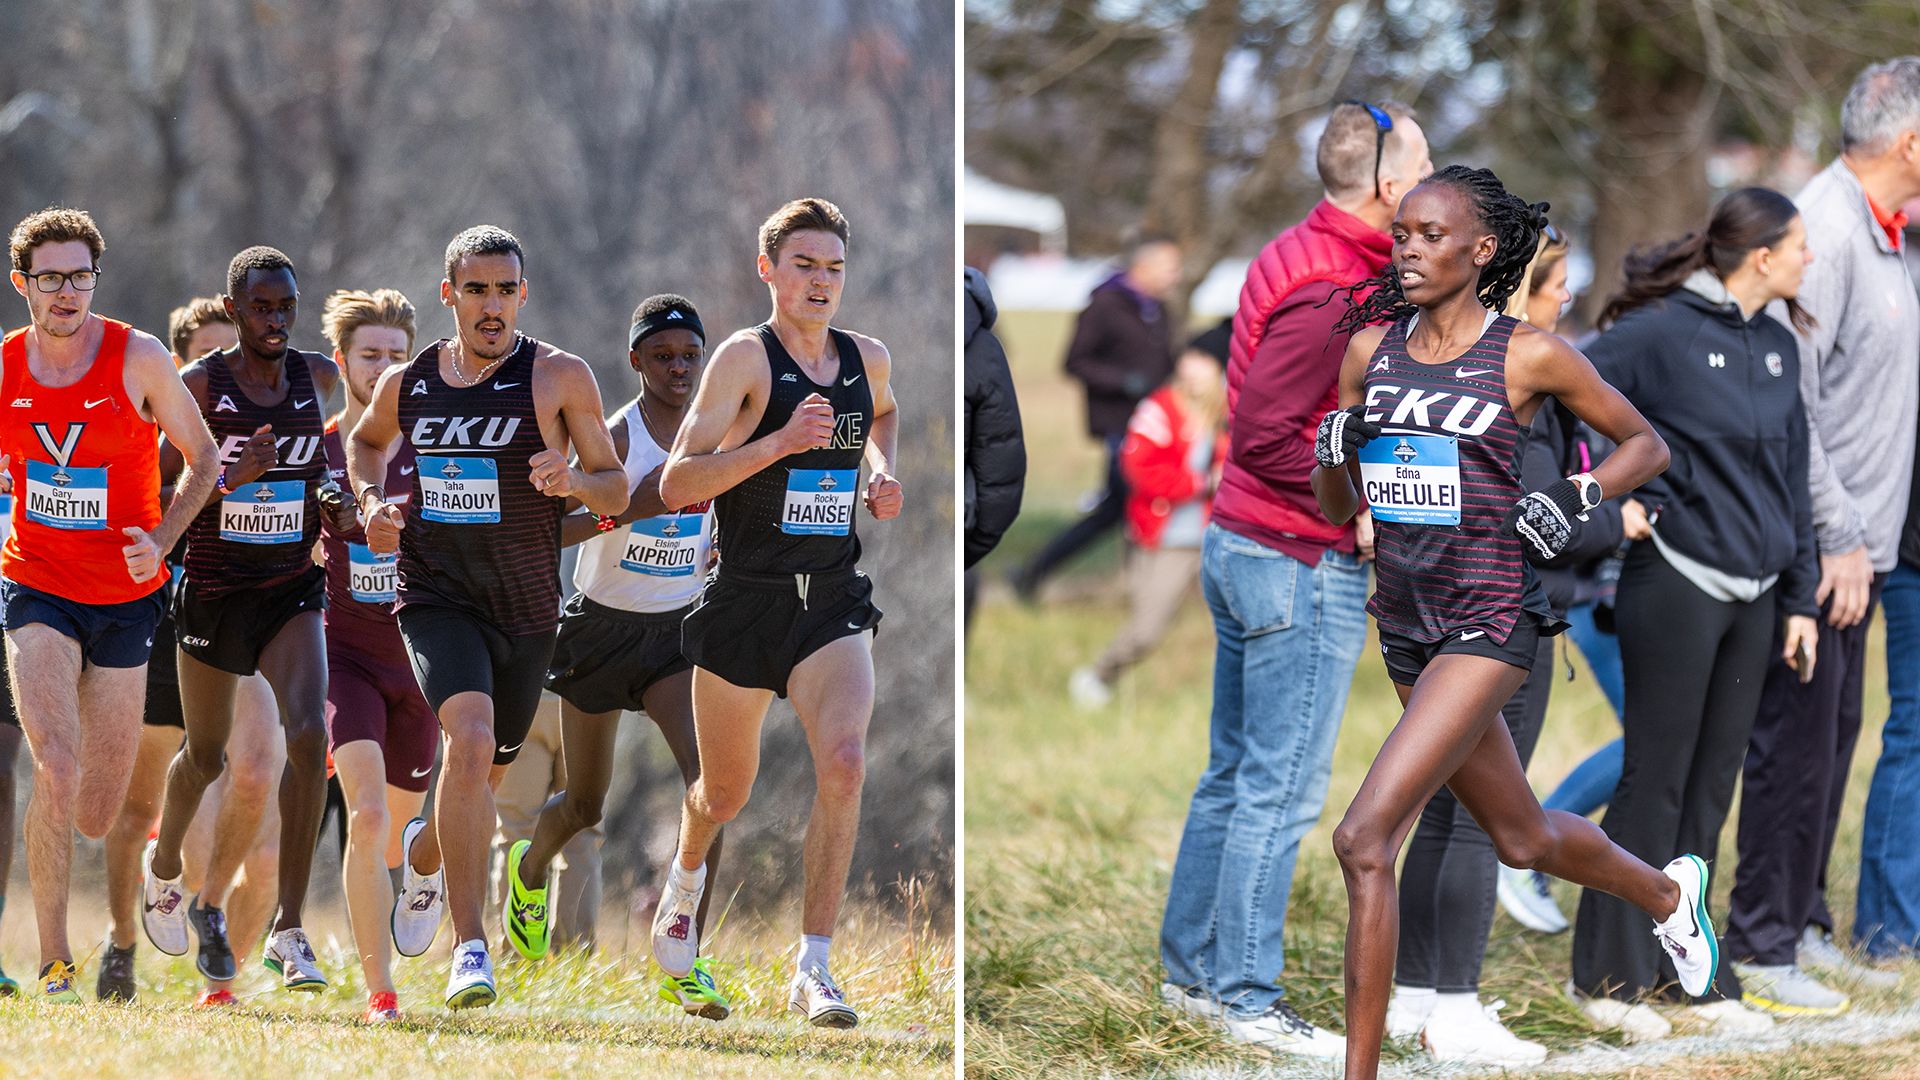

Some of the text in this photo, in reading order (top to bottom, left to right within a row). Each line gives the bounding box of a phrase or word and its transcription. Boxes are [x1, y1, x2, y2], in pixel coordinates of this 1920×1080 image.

[12, 398, 33, 407] ACC
[1364, 385, 1503, 436] EKU
[411, 416, 521, 446] EKU
[29, 422, 89, 467] V
[219, 435, 320, 465] EU
[1396, 467, 1420, 479] Edna
[52, 488, 72, 500] Gary
[444, 481, 464, 490] Taha
[1367, 481, 1455, 507] CHELULEI
[31, 492, 100, 517] MARTIN
[425, 490, 495, 509] ER RAOUY
[814, 494, 839, 504] Rocky
[253, 505, 276, 513] Brian
[225, 513, 299, 532] KIMUTAI
[655, 539, 681, 549] Elsingi
[626, 544, 695, 566] KIPRUTO
[371, 566, 395, 574] Georg
[353, 573, 398, 592] COUT
[183, 635, 210, 646] EKU
